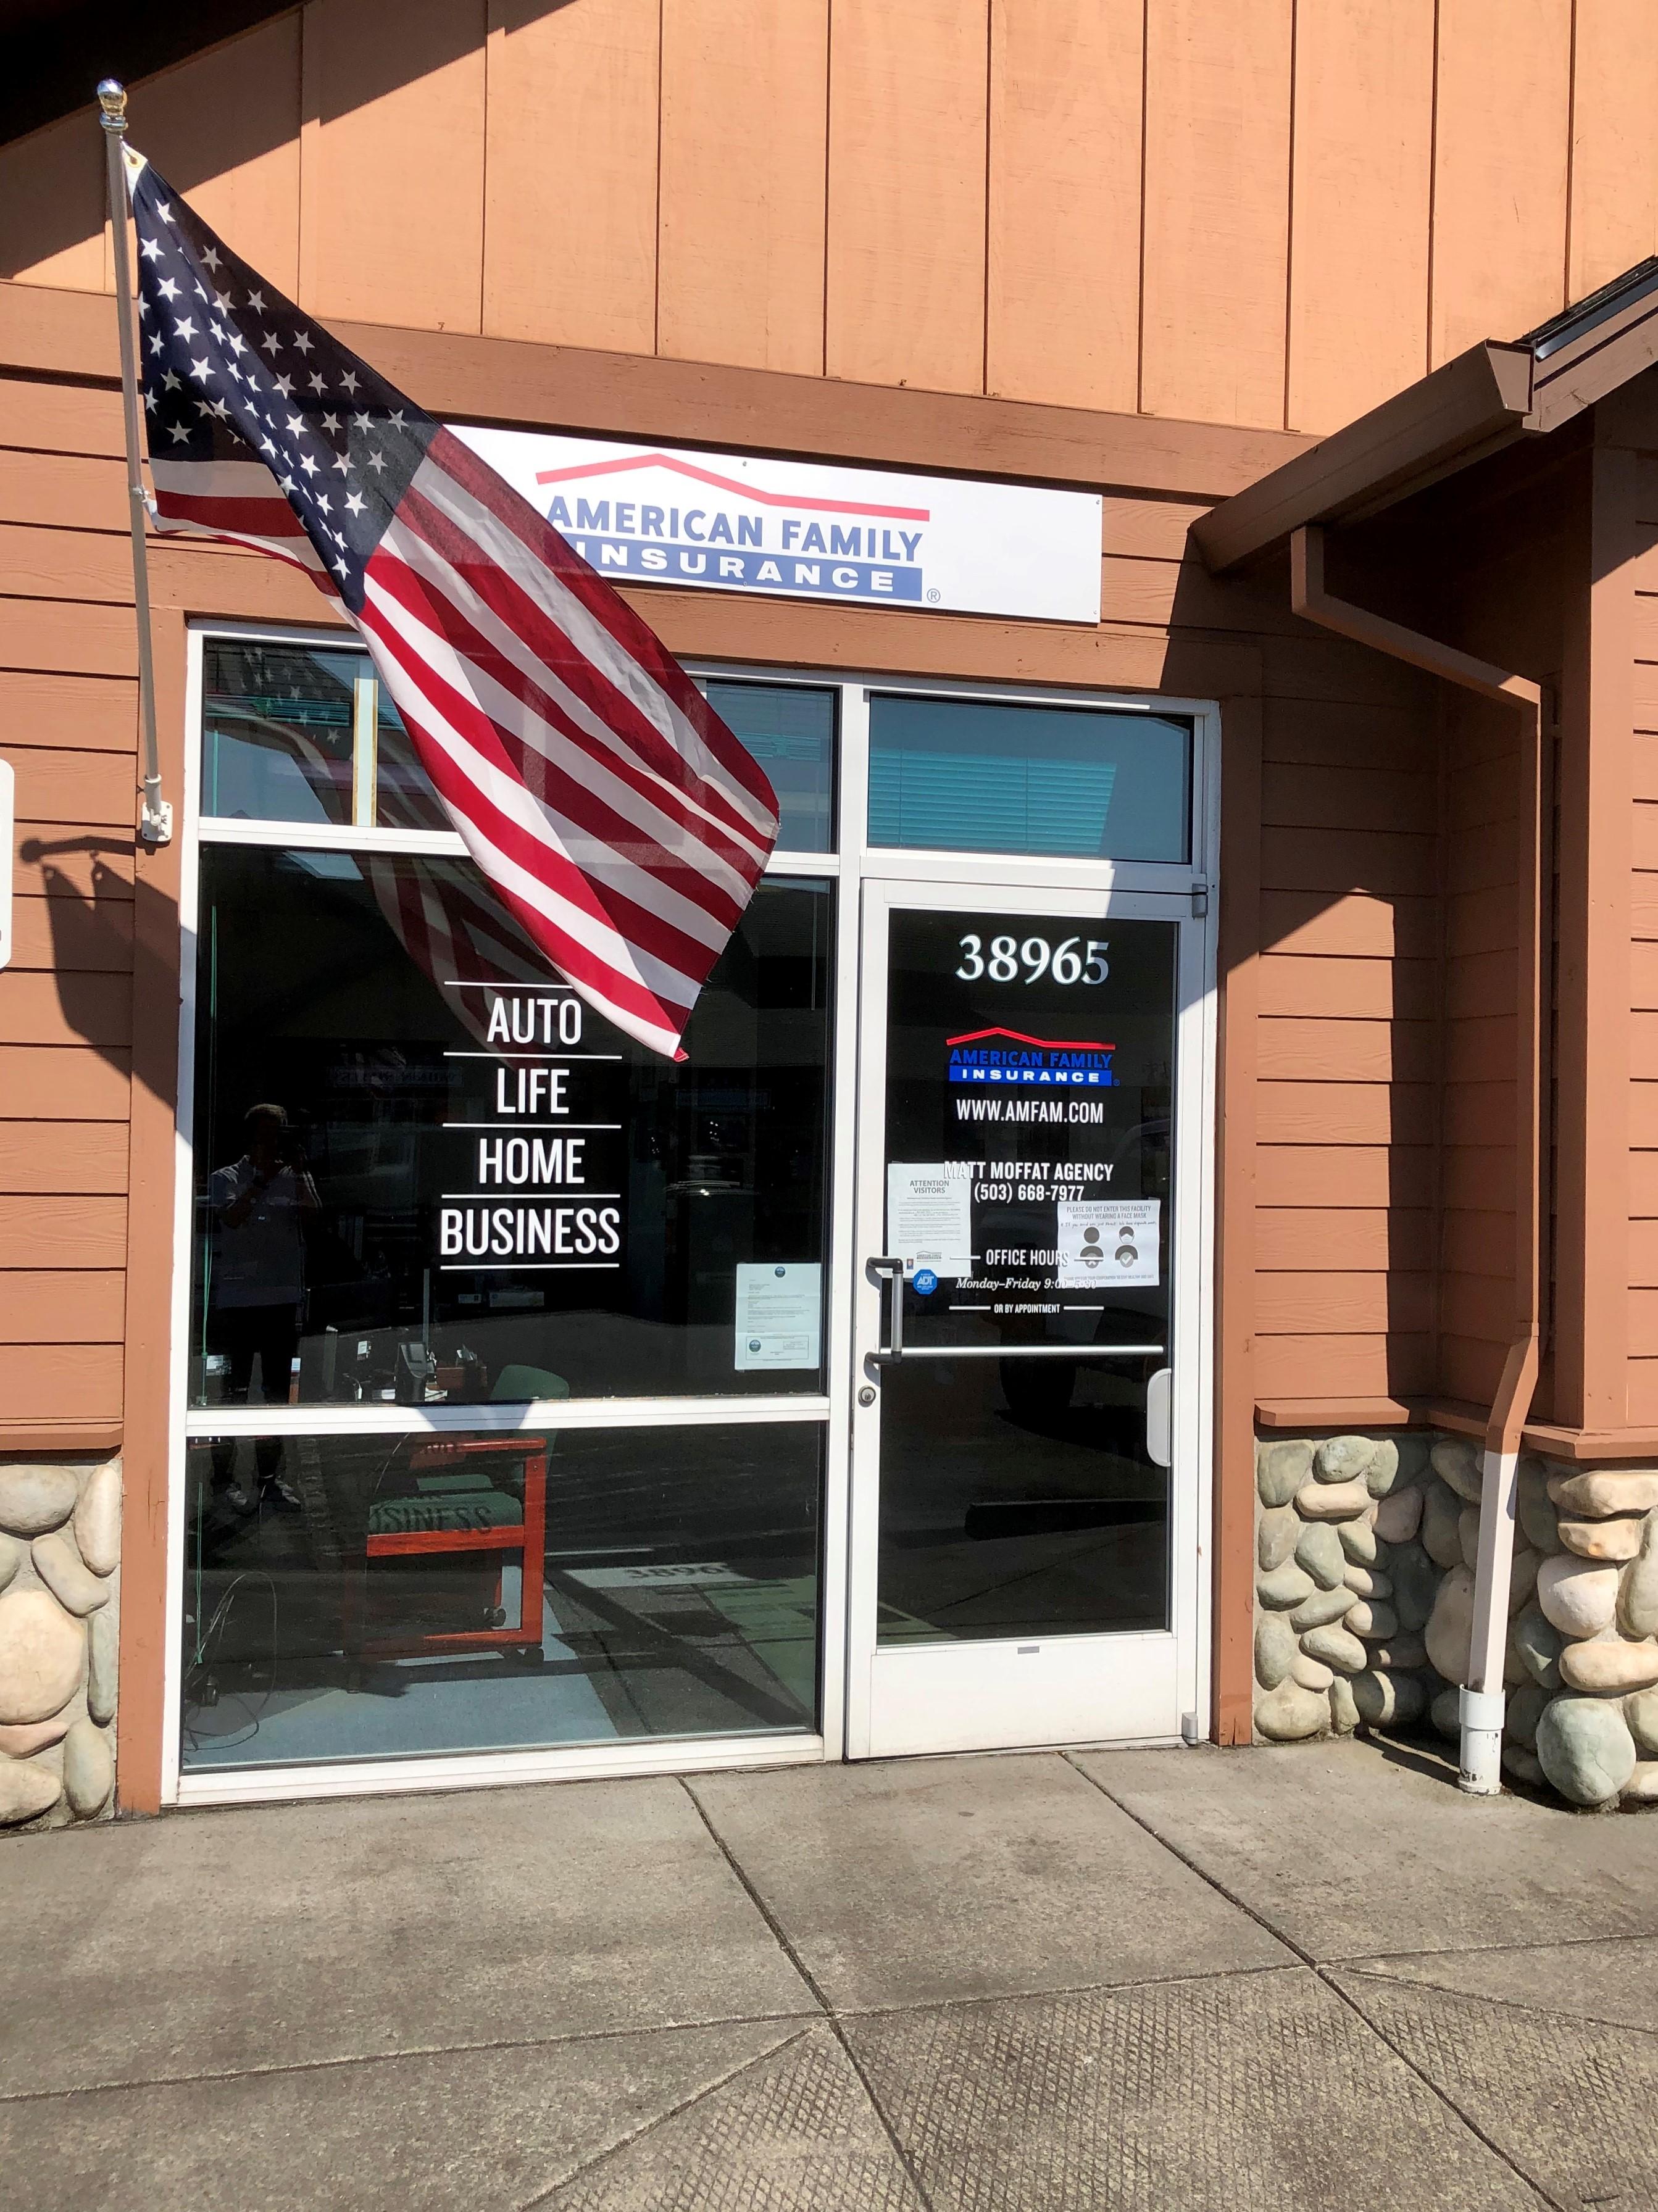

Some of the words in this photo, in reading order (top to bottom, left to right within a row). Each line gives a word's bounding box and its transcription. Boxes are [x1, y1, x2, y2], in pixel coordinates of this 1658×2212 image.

[547, 495, 763, 547] AMERICAN
[782, 519, 923, 562] FAMILY
[576, 541, 894, 592] INSURANCE
[955, 933, 1109, 985] 38965
[486, 997, 582, 1045] AUTO
[949, 1049, 1043, 1066] AMERICAN
[1050, 1052, 1112, 1068] FAMILY
[962, 1068, 1100, 1083] INSURANCE
[497, 1068, 570, 1114] LIFE
[956, 1099, 1104, 1124] WWW.AMFAM.COM
[479, 1137, 586, 1184] HOME
[944, 1161, 986, 1179] MATT
[990, 1162, 1051, 1180] MOFFAT
[1054, 1163, 1114, 1181] AGENCY
[974, 1182, 1013, 1204] (503)
[1019, 1184, 1085, 1202] 668-7977
[440, 1207, 620, 1255] BUSINESS
[986, 1249, 1027, 1265] OFFICE
[1030, 1250, 1069, 1267] HOURS
[917, 1276, 934, 1285] ADT
[994, 1304, 1003, 1313] OR
[1005, 1304, 1014, 1313] BY
[1014, 1304, 1060, 1314] APPOINTMENT
